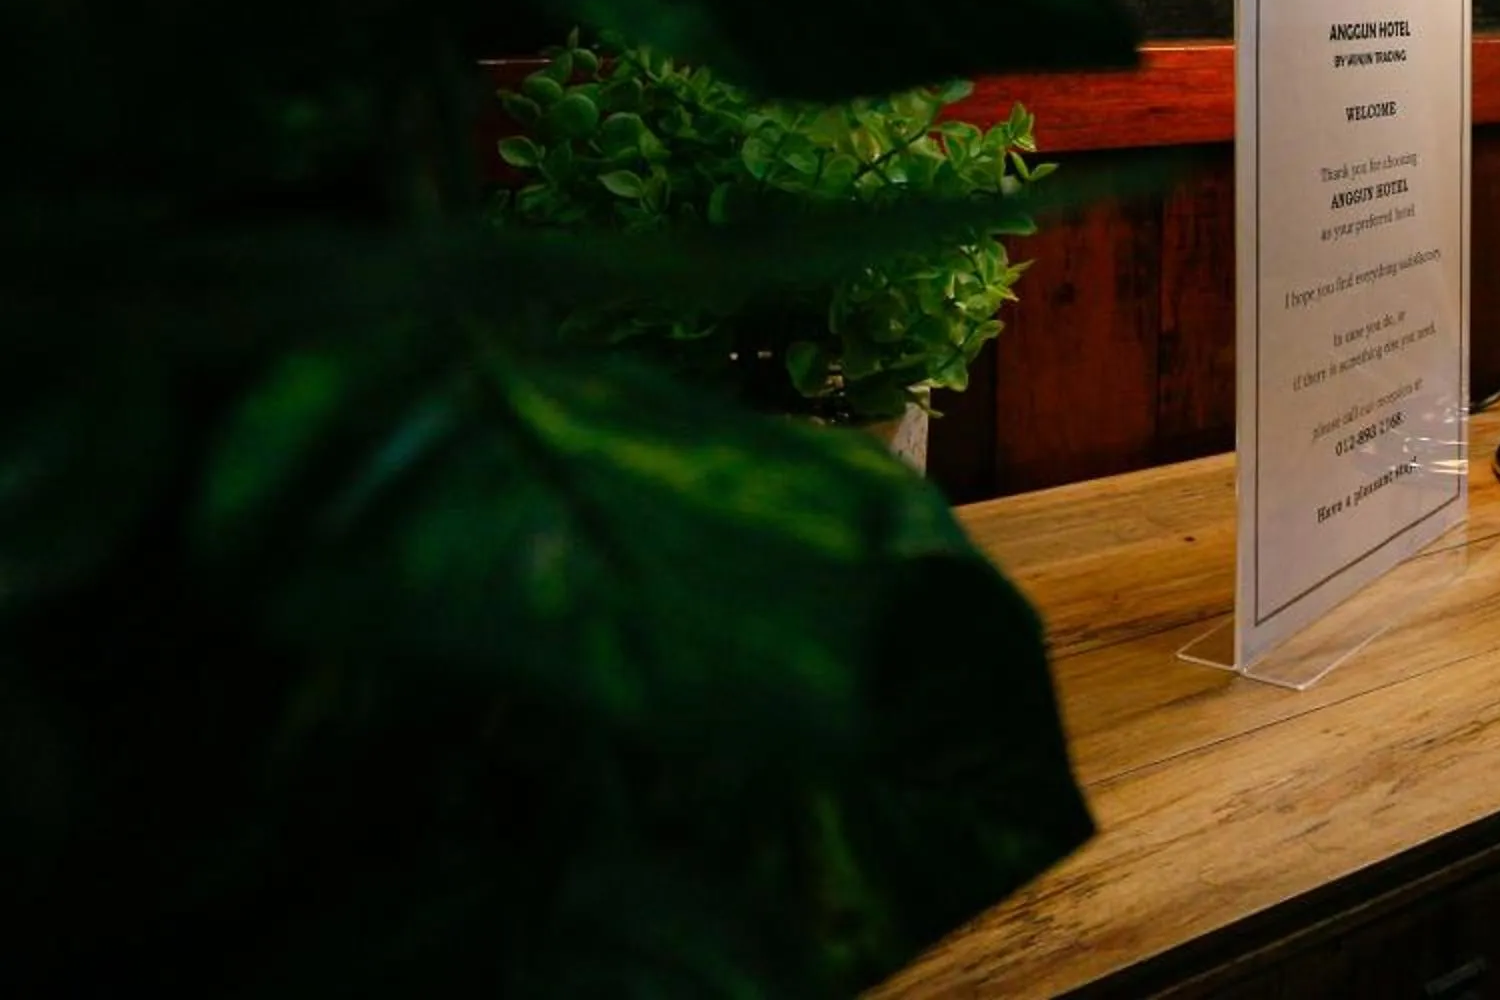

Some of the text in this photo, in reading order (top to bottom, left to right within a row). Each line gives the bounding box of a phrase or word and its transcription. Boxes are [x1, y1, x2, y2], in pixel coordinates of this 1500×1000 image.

[1329, 21, 1411, 41] ANGGUN HOTEL
[1334, 55, 1345, 68] BY
[1345, 101, 1397, 122] WELCOME
[1321, 154, 1418, 183] Thank you for choosing
[1331, 178, 1408, 209] ANGGUN HOTEL
[1321, 227, 1332, 242] as
[1334, 223, 1353, 241] your
[1355, 208, 1393, 235] preferred
[1285, 294, 1290, 310] I
[1291, 289, 1315, 309] hope
[1317, 283, 1334, 302] you
[1336, 272, 1354, 292] find
[1355, 263, 1398, 287] everything
[1365, 320, 1381, 339] you
[1317, 501, 1343, 524] Have
[1345, 495, 1351, 508] a
[1354, 471, 1393, 507] pleasant
